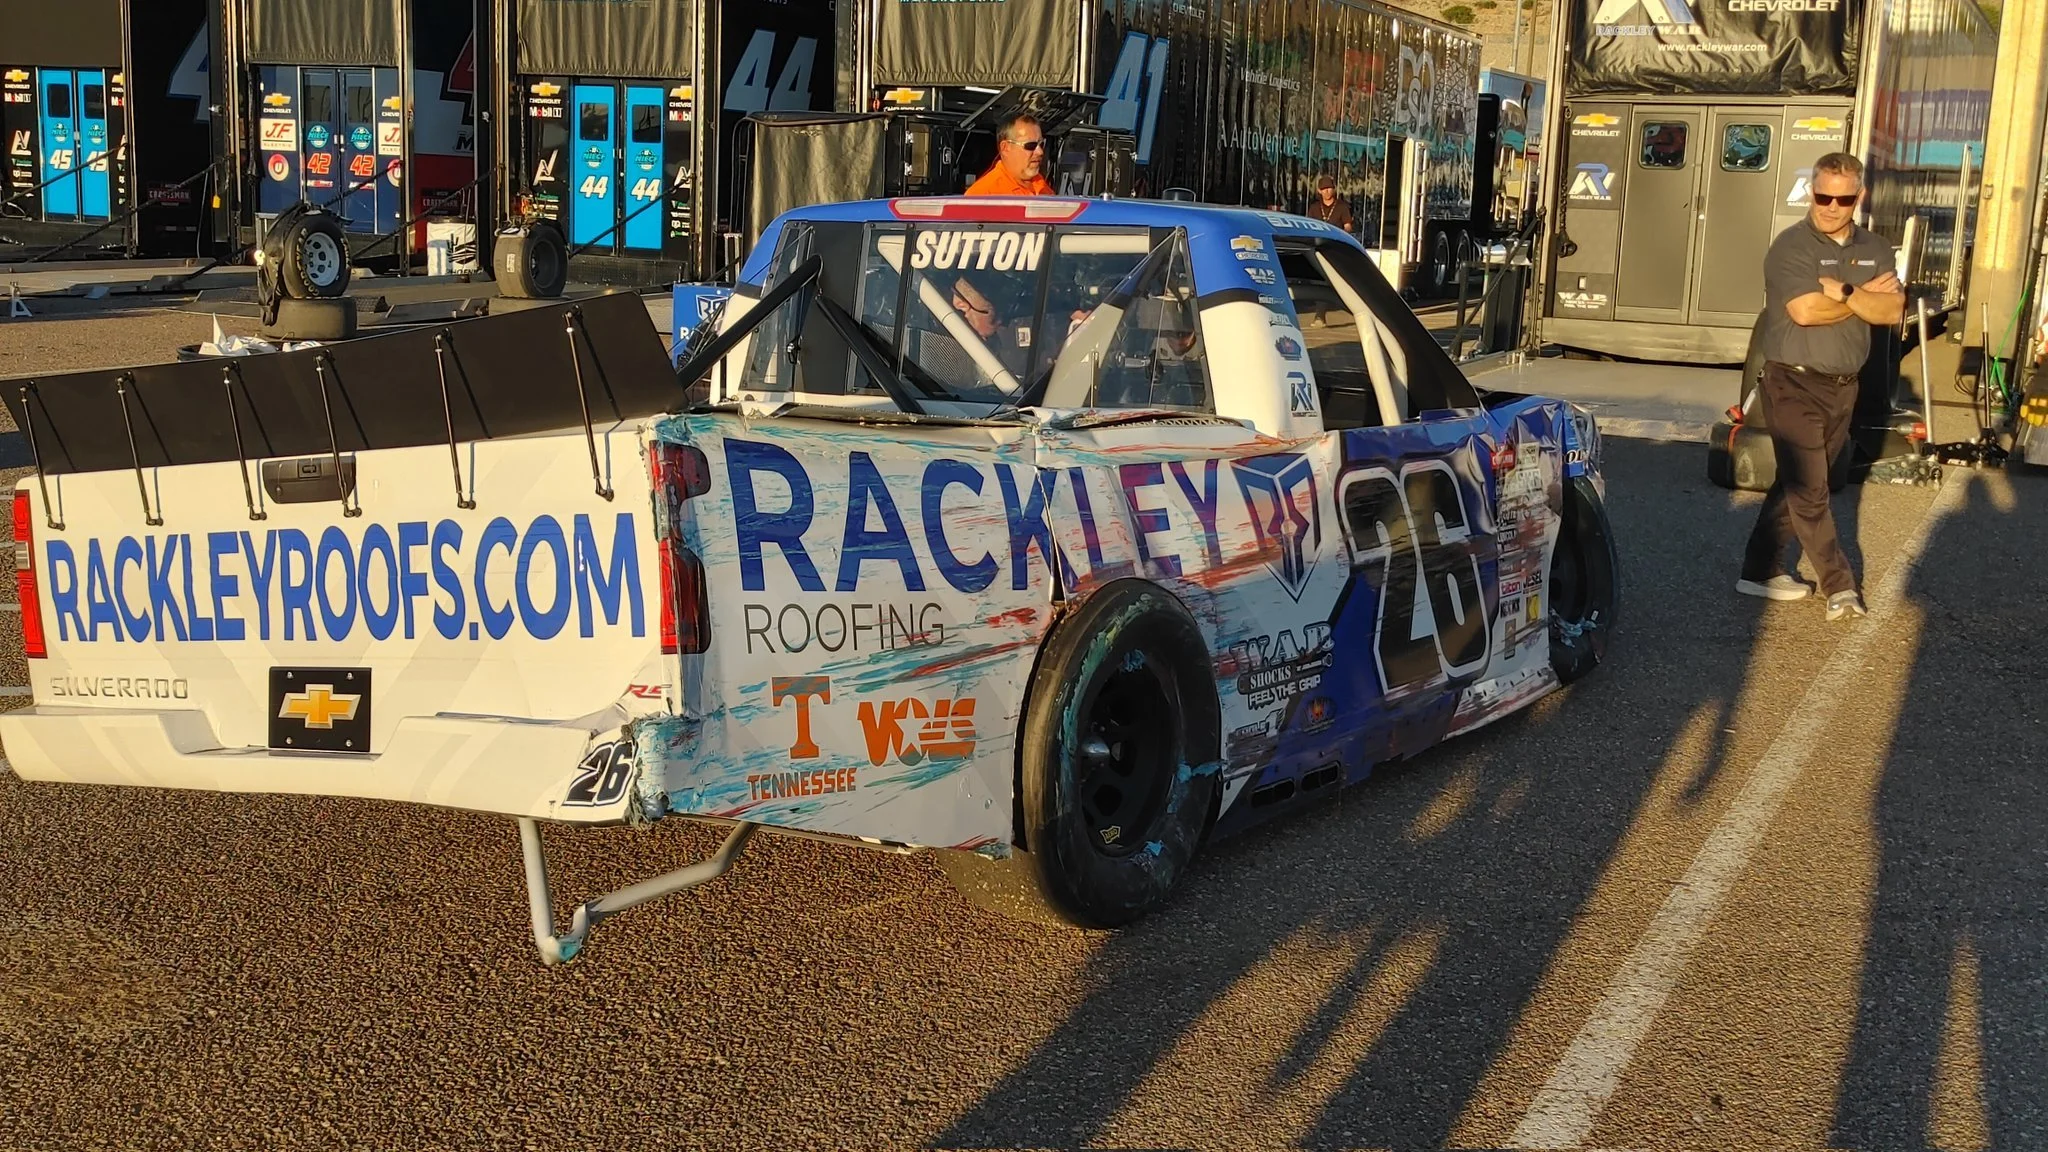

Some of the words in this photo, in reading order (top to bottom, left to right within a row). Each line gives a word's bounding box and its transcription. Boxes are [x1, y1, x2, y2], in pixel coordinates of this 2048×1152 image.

[1729, 0, 1838, 12] CHEVROLET
[1596, 24, 1654, 36] RACKLEY
[1658, 42, 1767, 53] www.rackleywar.com
[724, 29, 818, 112] 44
[1240, 66, 1268, 84] Vehicle
[1269, 72, 1300, 92] Logistics
[529, 106, 552, 118] Mobil
[1231, 123, 1298, 155] AutoVentive
[49, 149, 73, 170] 45
[86, 151, 107, 172] 45
[307, 153, 331, 174] 42
[350, 154, 375, 176] 42
[580, 175, 608, 199] 44
[631, 178, 661, 201] 44
[1264, 215, 1332, 232] SUTTON
[911, 231, 1048, 271] SUTTON
[723, 437, 1222, 593] RACKLEY
[46, 513, 646, 644] RACKLEYROOFS.COM
[1334, 460, 1491, 698] 26
[744, 602, 944, 654] ROOFING
[51, 677, 188, 700] SILVERADO
[1249, 664, 1292, 690] SHOCKS
[1249, 689, 1275, 709] FEEL
[1275, 681, 1297, 700] THE
[1299, 674, 1321, 693] GRIP
[771, 675, 830, 760] T
[561, 739, 639, 807] 26
[747, 767, 857, 801] TENNESSEE
